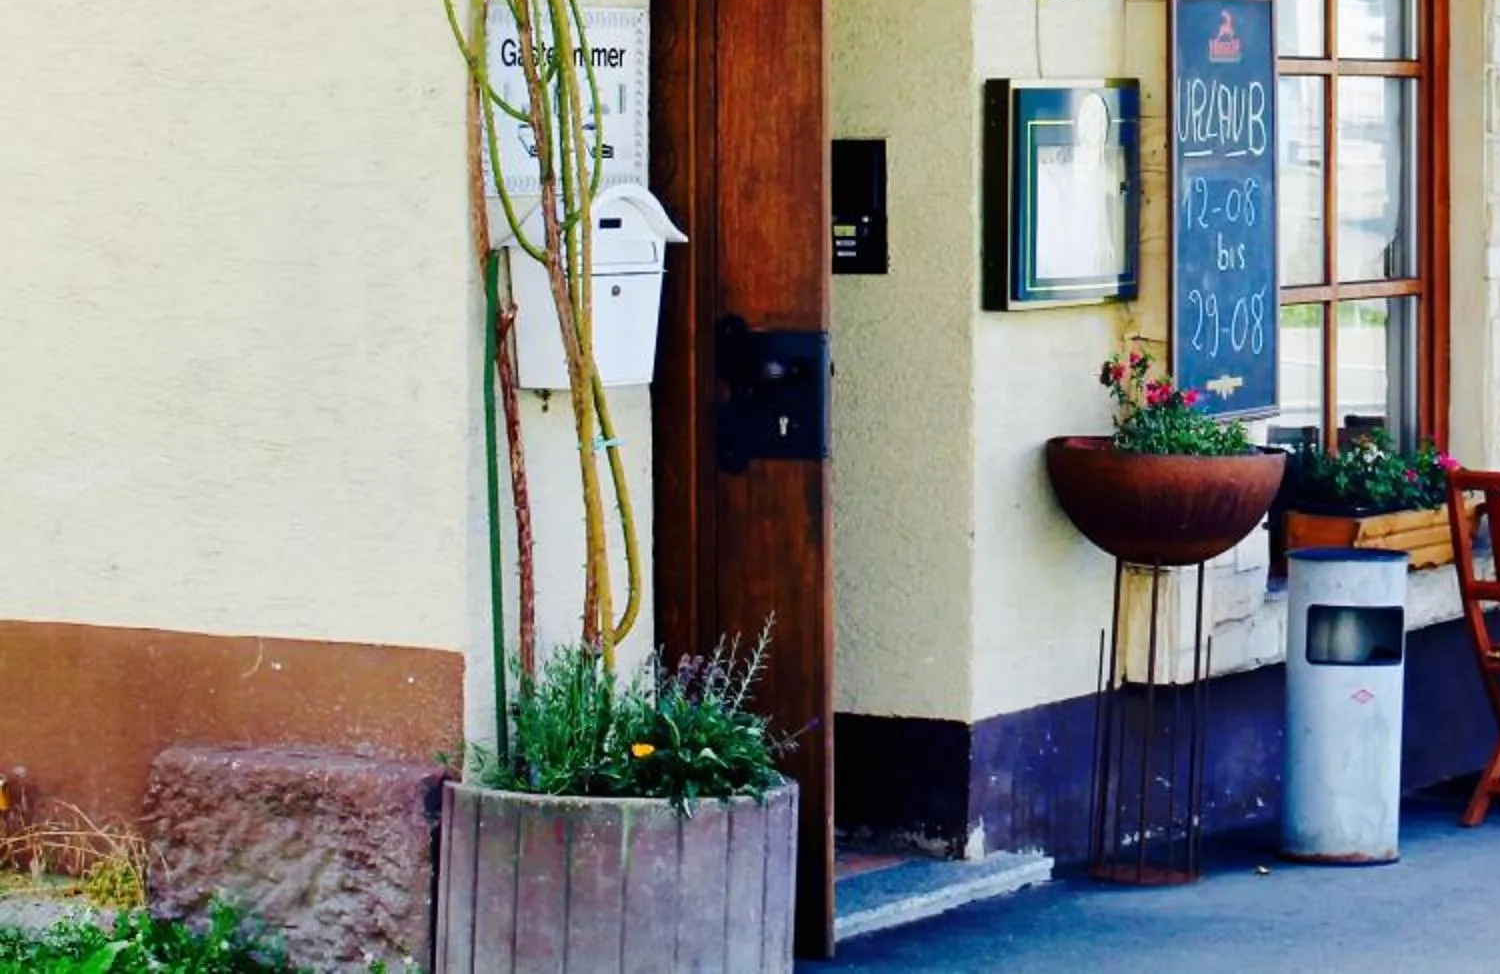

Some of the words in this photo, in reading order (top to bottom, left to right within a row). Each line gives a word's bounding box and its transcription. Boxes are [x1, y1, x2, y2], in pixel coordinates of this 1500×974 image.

[1177, 77, 1267, 156] URLAUB
[1182, 177, 1259, 229] 12-08
[1217, 232, 1246, 270] bis
[1189, 284, 1267, 358] 29-08
